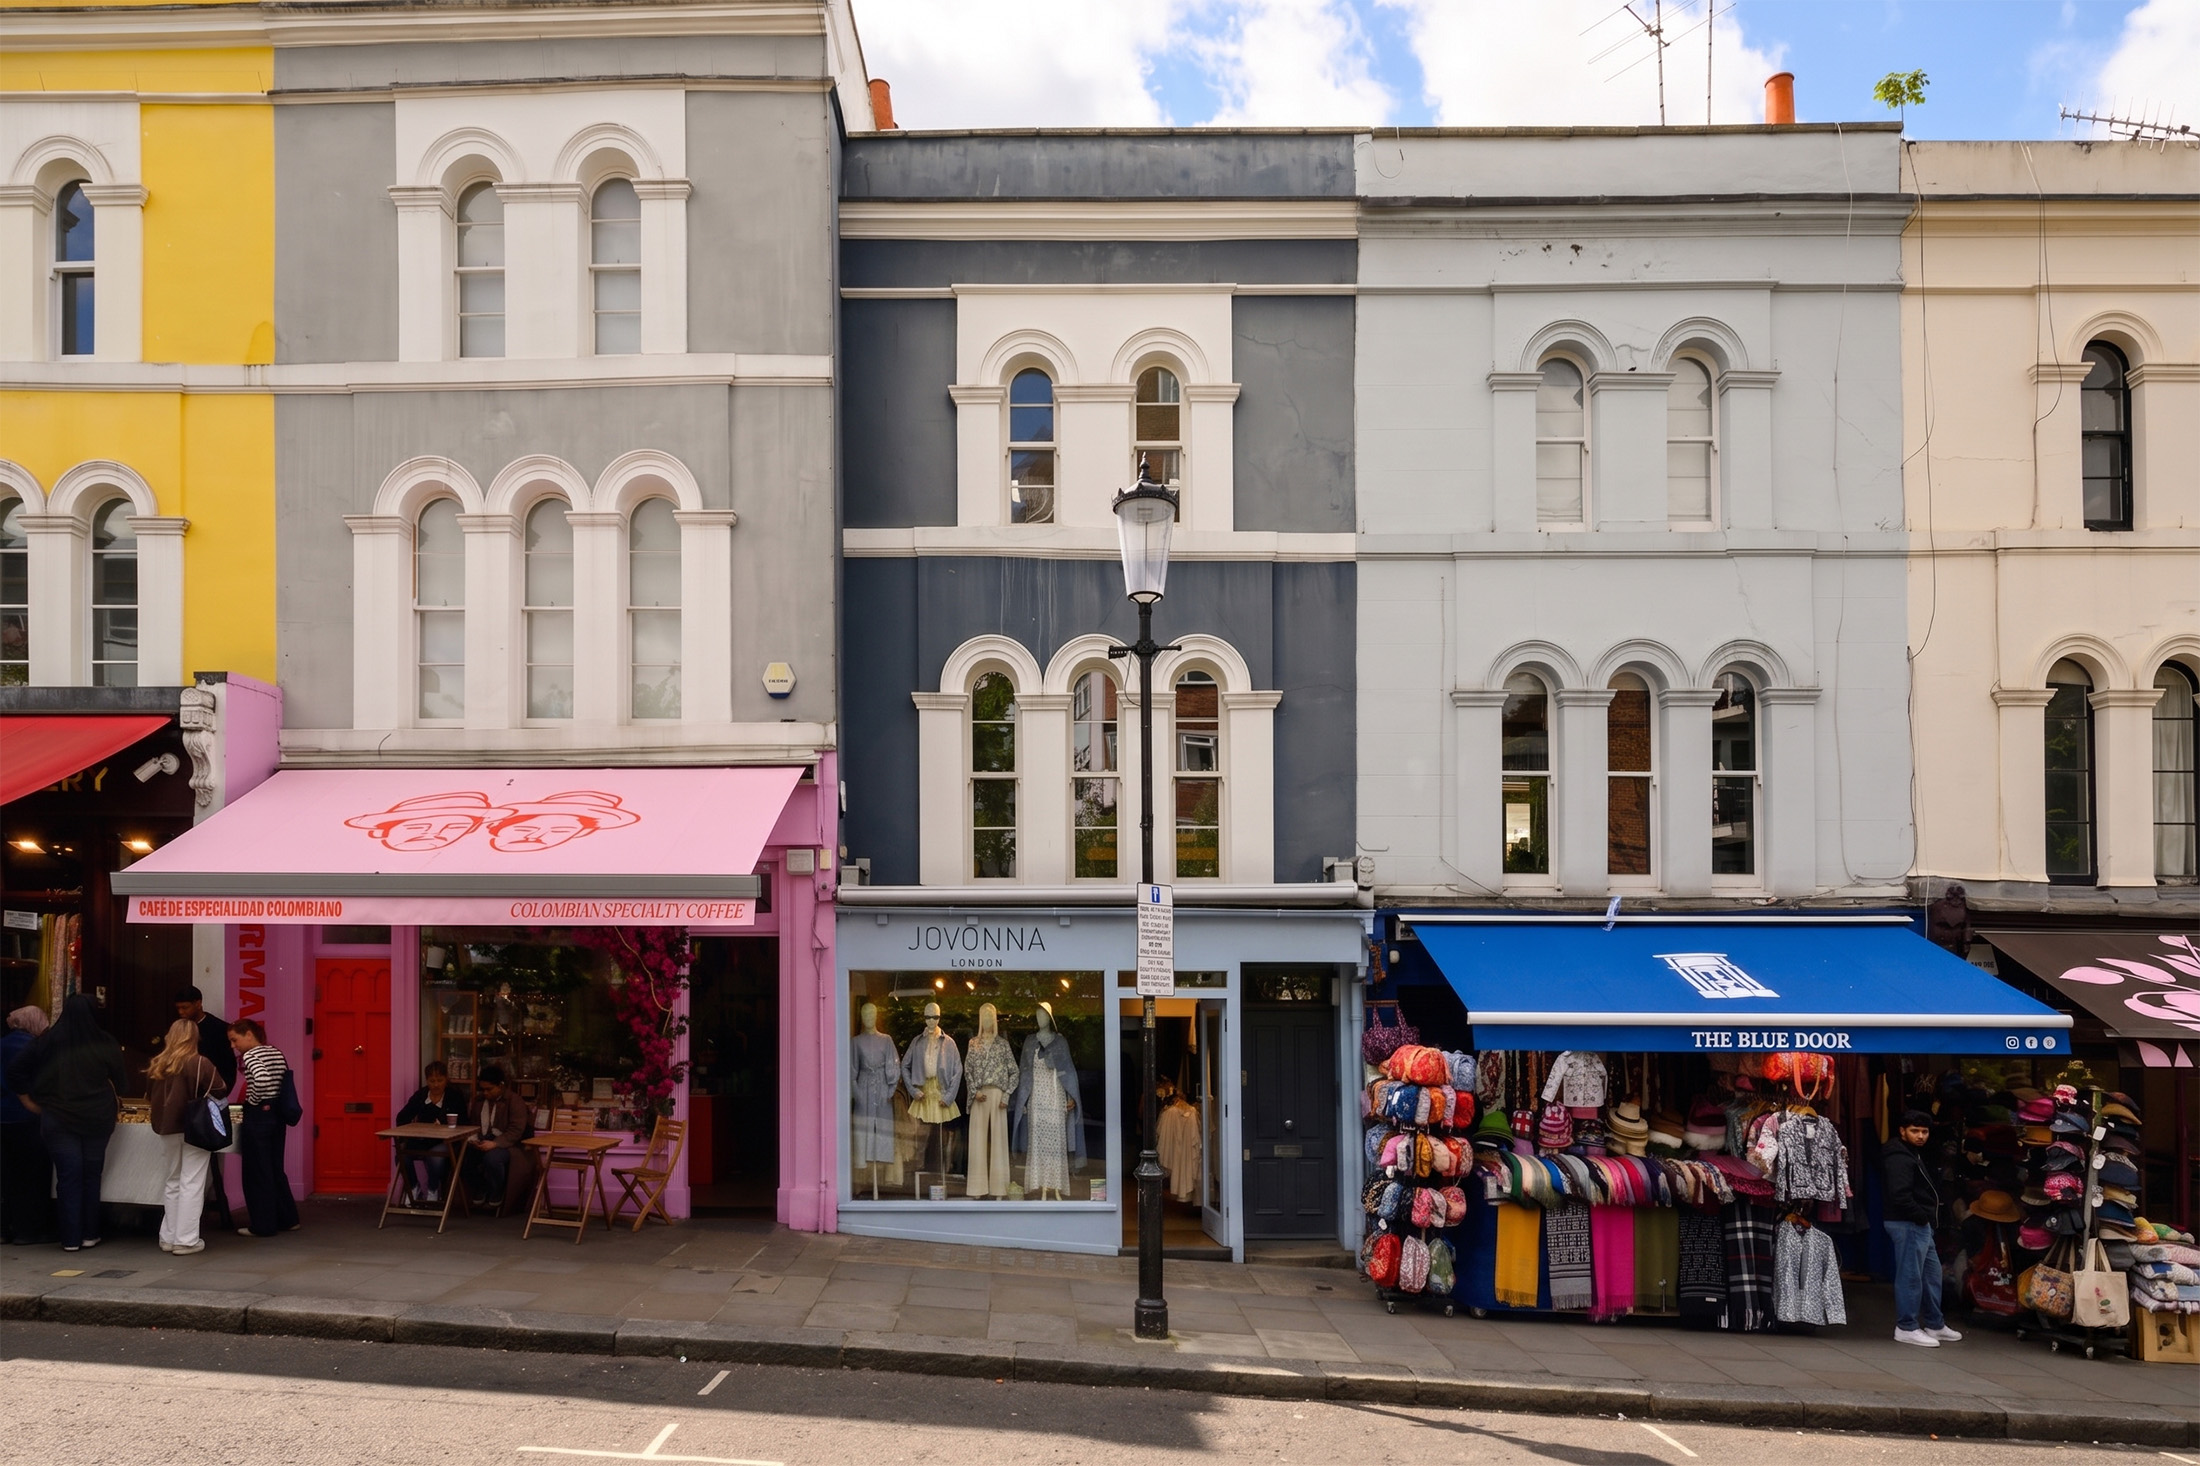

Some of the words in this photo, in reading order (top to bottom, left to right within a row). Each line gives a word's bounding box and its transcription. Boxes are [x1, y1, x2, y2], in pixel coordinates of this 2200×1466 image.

[42, 766, 109, 792] RY
[139, 898, 167, 917] CAFÉ
[168, 900, 183, 917] DE
[184, 900, 265, 917] ESPECIALIDAD
[266, 900, 343, 917] COLOMBIANO
[510, 902, 602, 918] COLOMBIAN
[602, 902, 685, 919] SPECIALTY
[686, 903, 746, 919] COFFEE
[908, 926, 1046, 951] JOVONNA
[951, 958, 1003, 967] LONDON
[1691, 1031, 1733, 1049] THE
[1737, 1032, 1790, 1049] BLUE
[1794, 1032, 1852, 1049] DOOR
